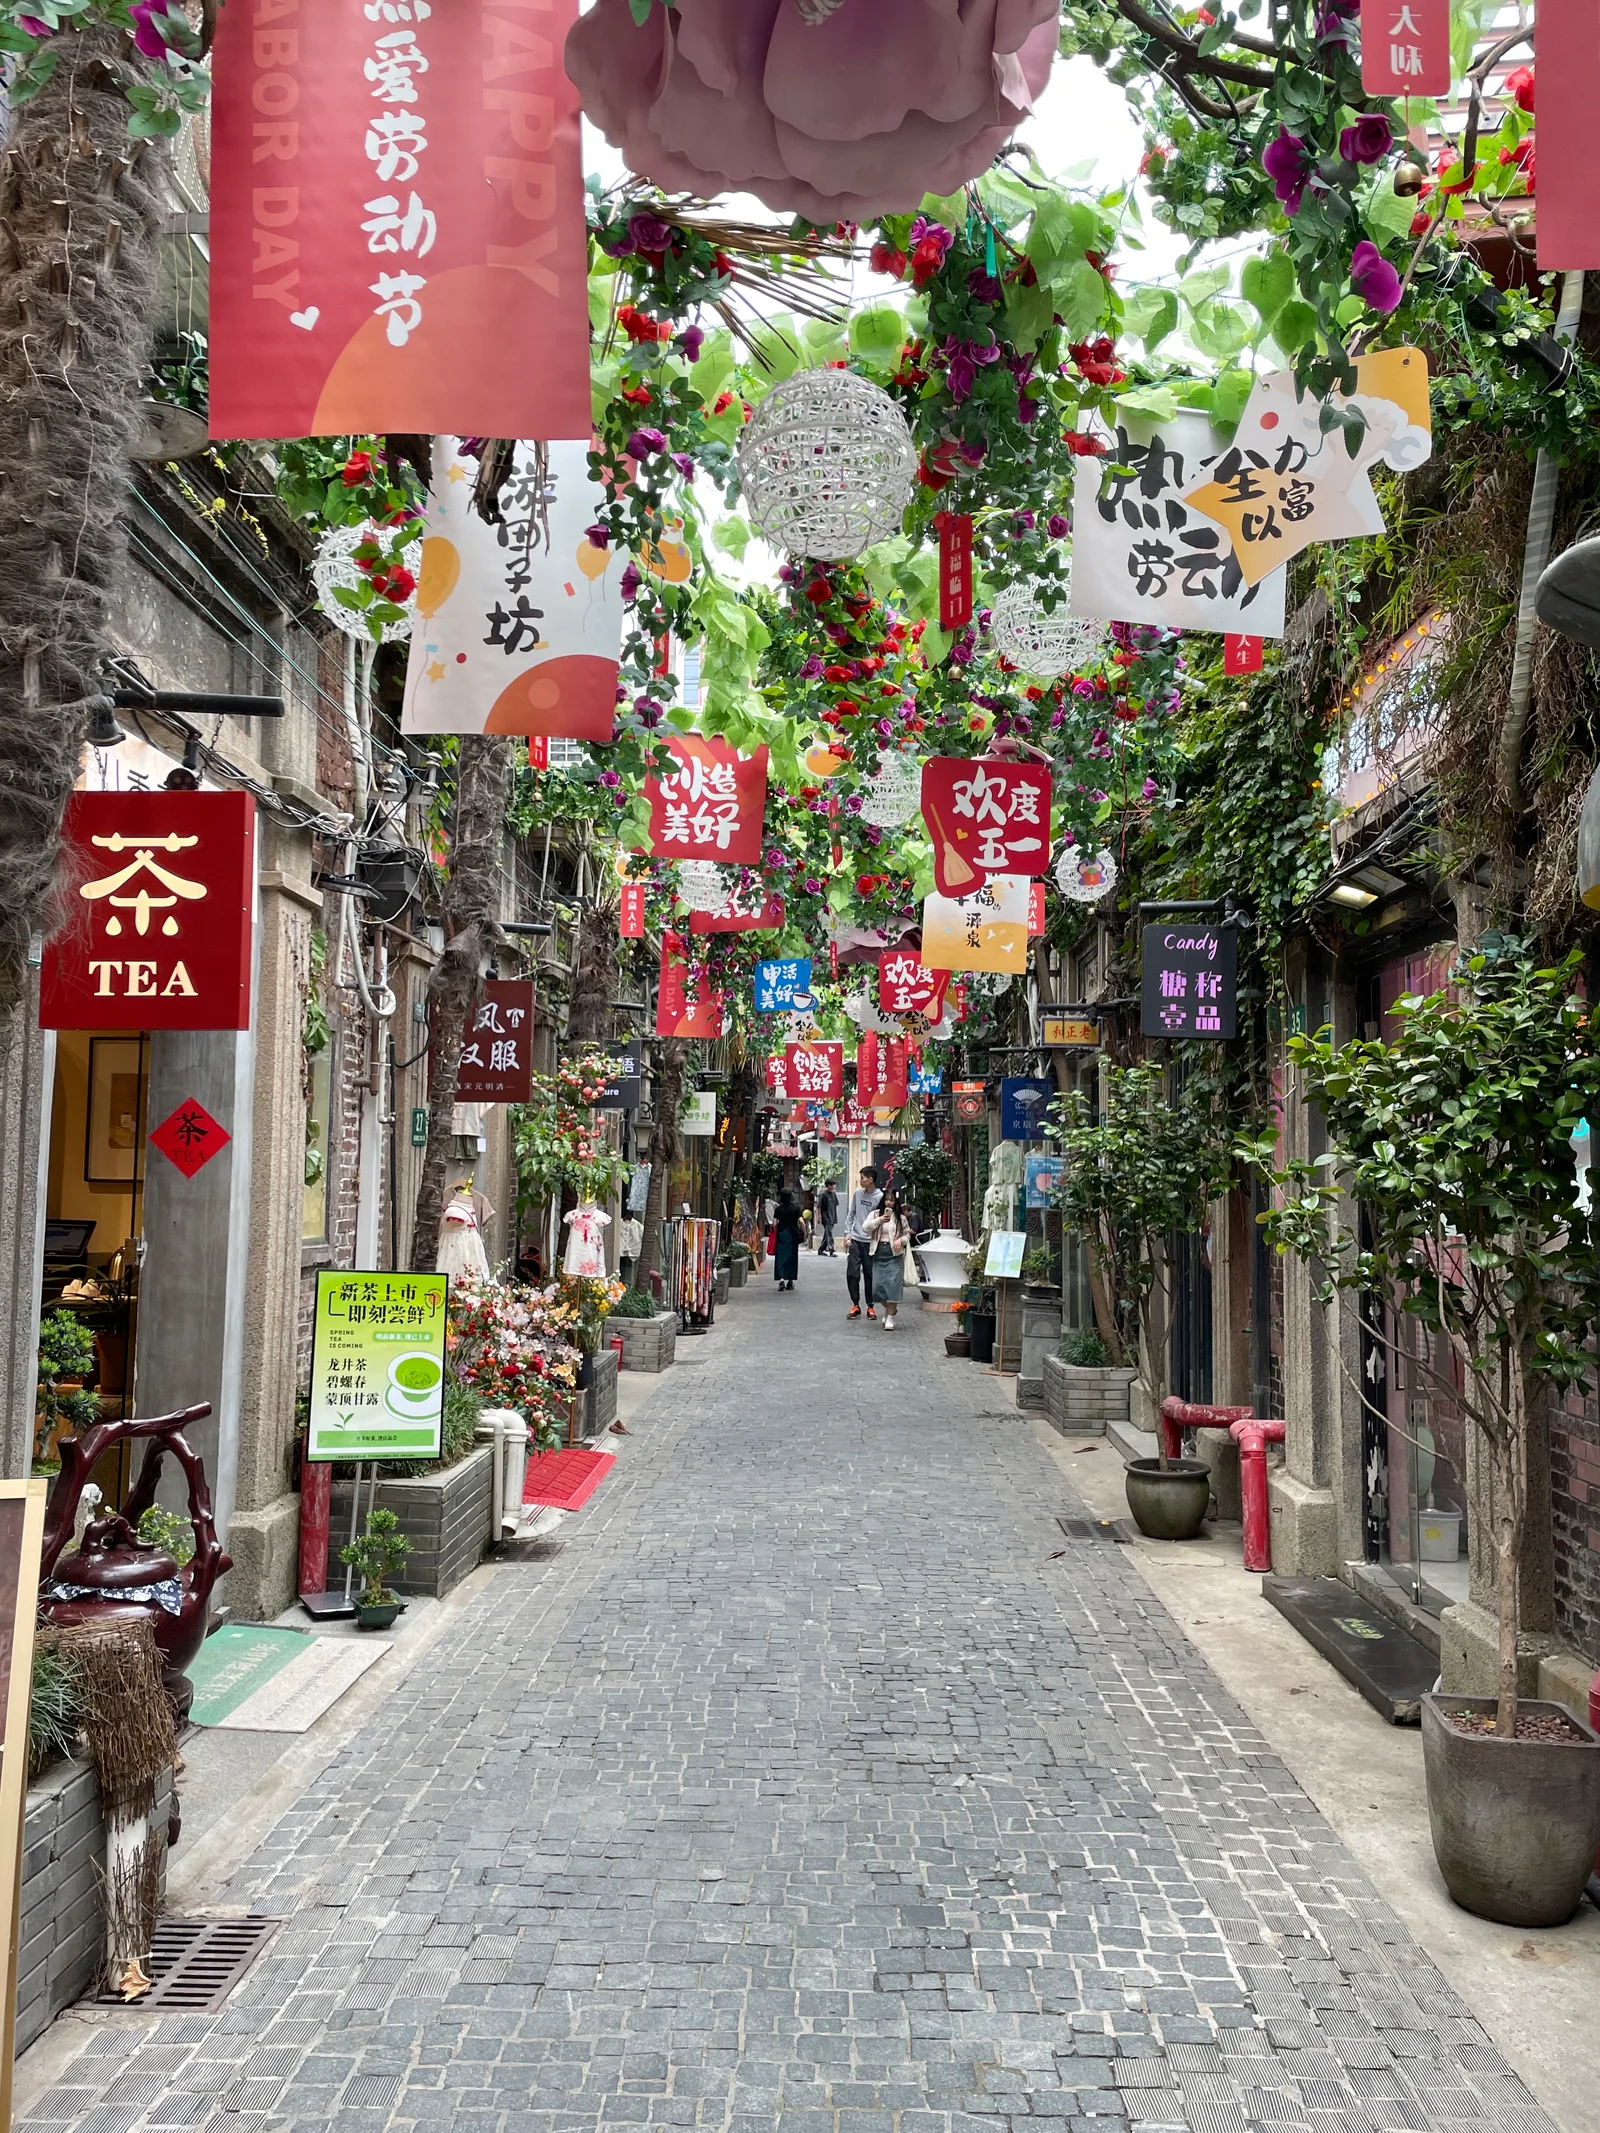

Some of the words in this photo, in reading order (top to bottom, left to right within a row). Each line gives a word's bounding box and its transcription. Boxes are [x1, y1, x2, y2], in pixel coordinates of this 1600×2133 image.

[481, 0, 560, 299] APPY
[252, 186, 300, 310] DAY
[952, 765, 1041, 825] 欢度
[660, 801, 740, 849] 美好
[972, 828, 1042, 868] 五一
[79, 832, 208, 936] 茶
[966, 912, 982, 948] 源泉
[1164, 932, 1219, 960] Candy
[88, 960, 199, 996] TEA
[763, 963, 797, 987] 申活
[884, 954, 935, 986] 欢度
[760, 984, 794, 1009] 美好
[893, 987, 931, 1010] 五一
[792, 1049, 831, 1073] 创造
[798, 1071, 833, 1092] 美好
[173, 1111, 209, 1147] 茶
[171, 1148, 206, 1163] TEA
[340, 1282, 417, 1302] 新茶上市
[348, 1305, 425, 1324] 即刻尝鲜
[327, 1358, 368, 1371] 龙井茶
[326, 1375, 366, 1389] 碧螺春
[325, 1392, 379, 1406] 蒙顶甘露
